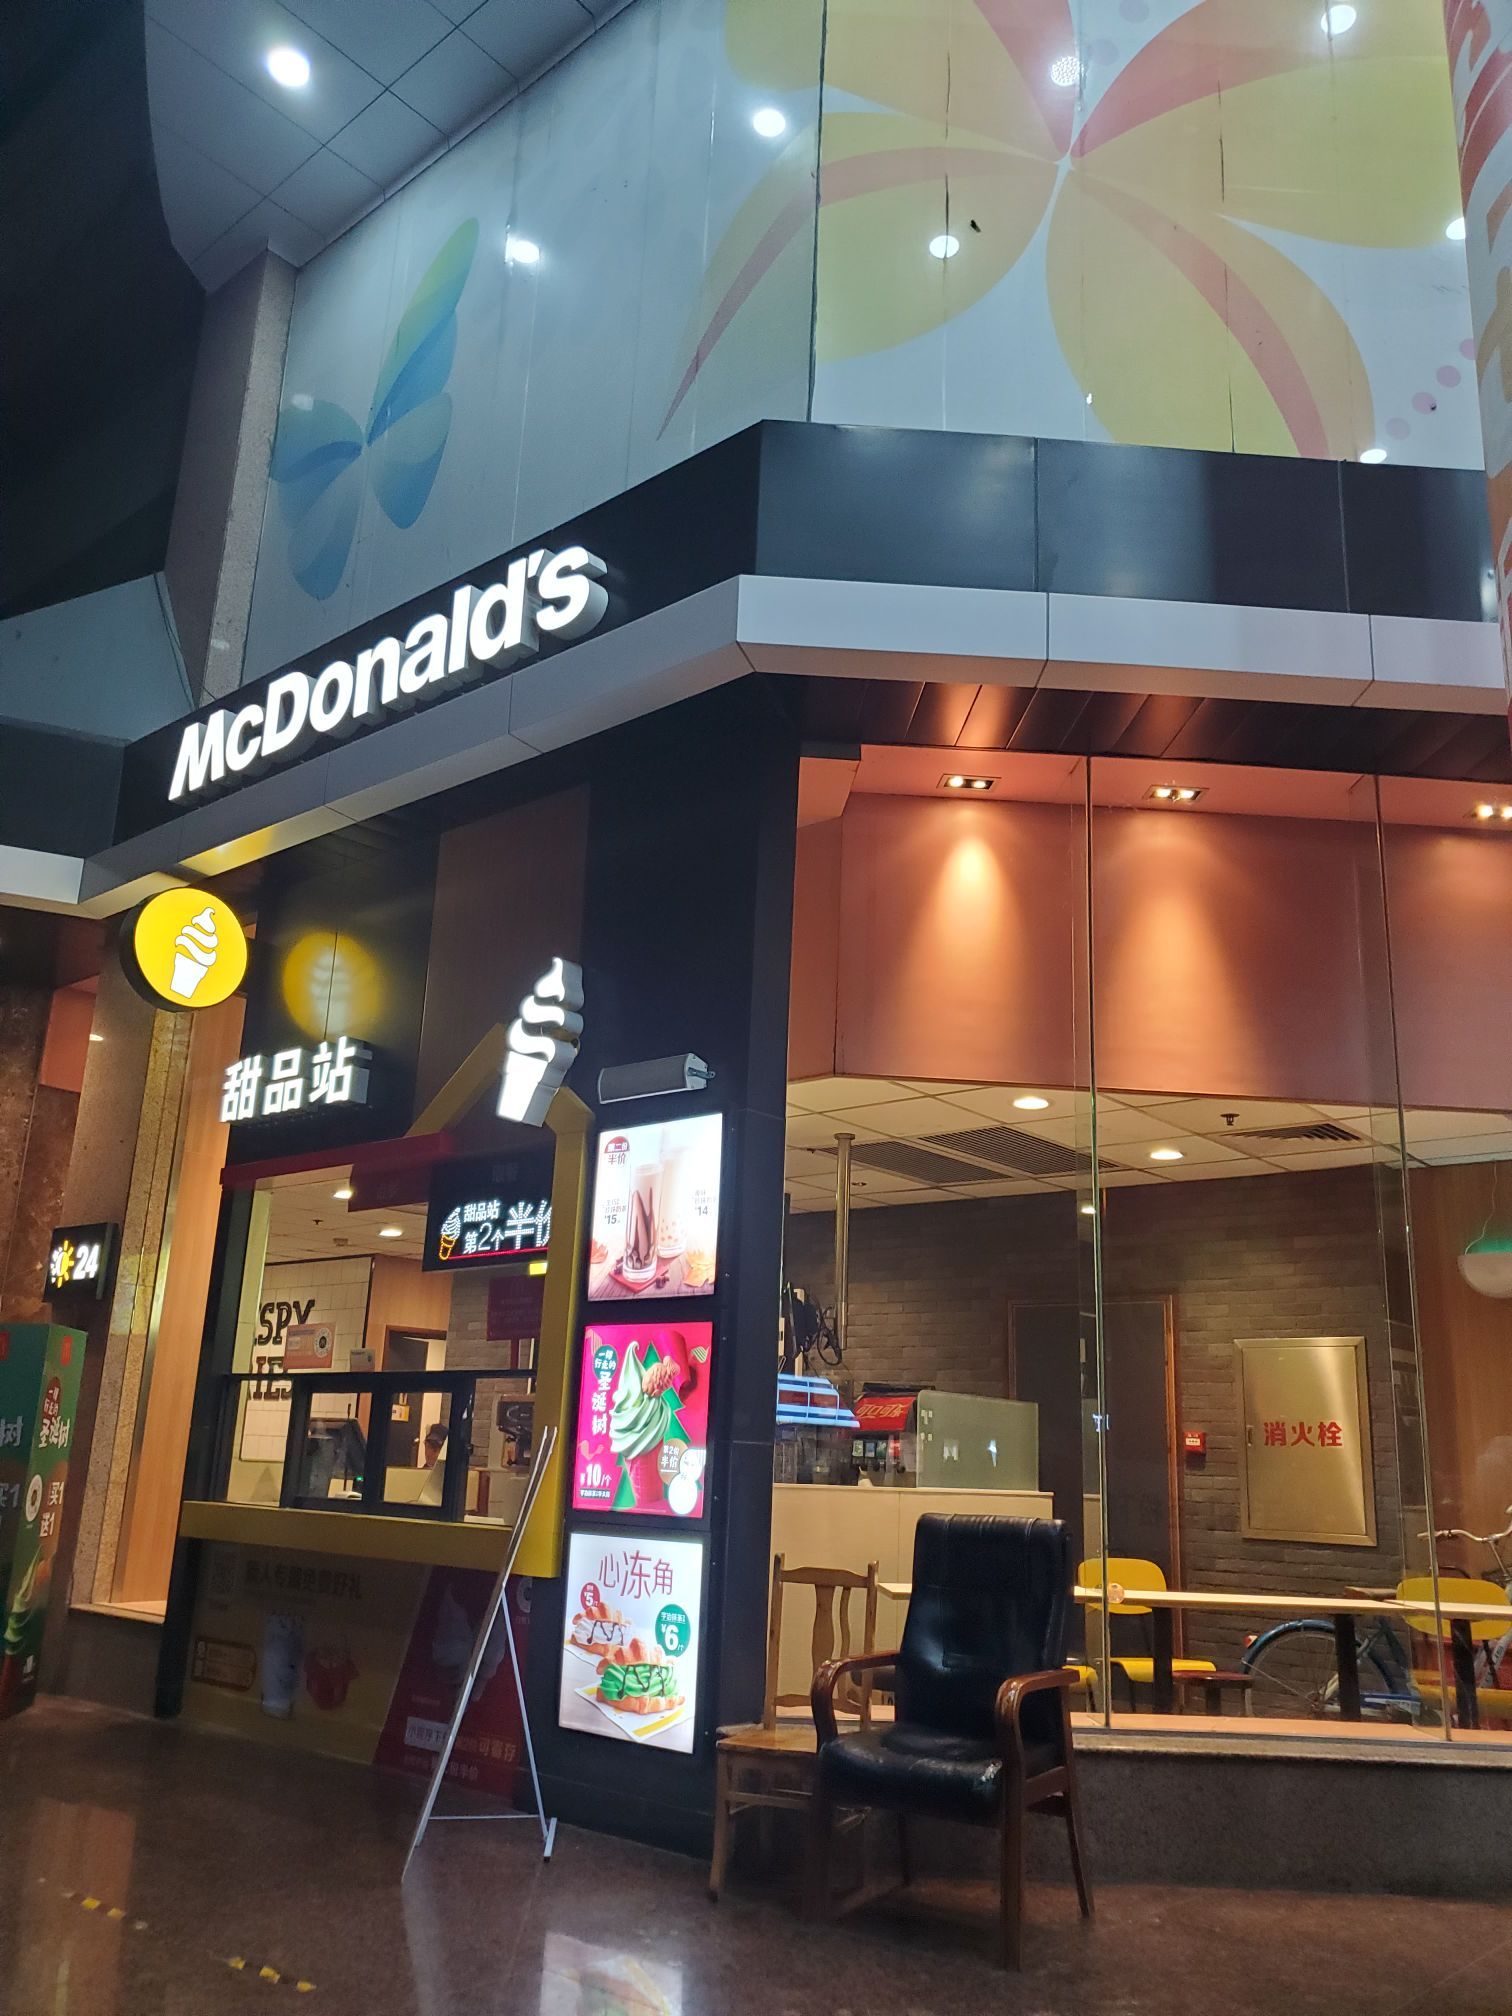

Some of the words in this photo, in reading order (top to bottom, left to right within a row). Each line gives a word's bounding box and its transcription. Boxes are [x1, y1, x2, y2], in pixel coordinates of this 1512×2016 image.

[168, 545, 601, 801] McDonald's
[220, 1035, 362, 1122] 甜品站
[608, 1153, 626, 1165] 半价
[463, 1199, 501, 1222] 甜品站
[462, 1222, 505, 1254] 第2个
[73, 1242, 101, 1281] 24
[254, 1299, 315, 1345] SPY
[591, 1371, 612, 1436] 圣诞树
[1263, 1421, 1343, 1448] 消火栓
[598, 1550, 674, 1599] 心冻角
